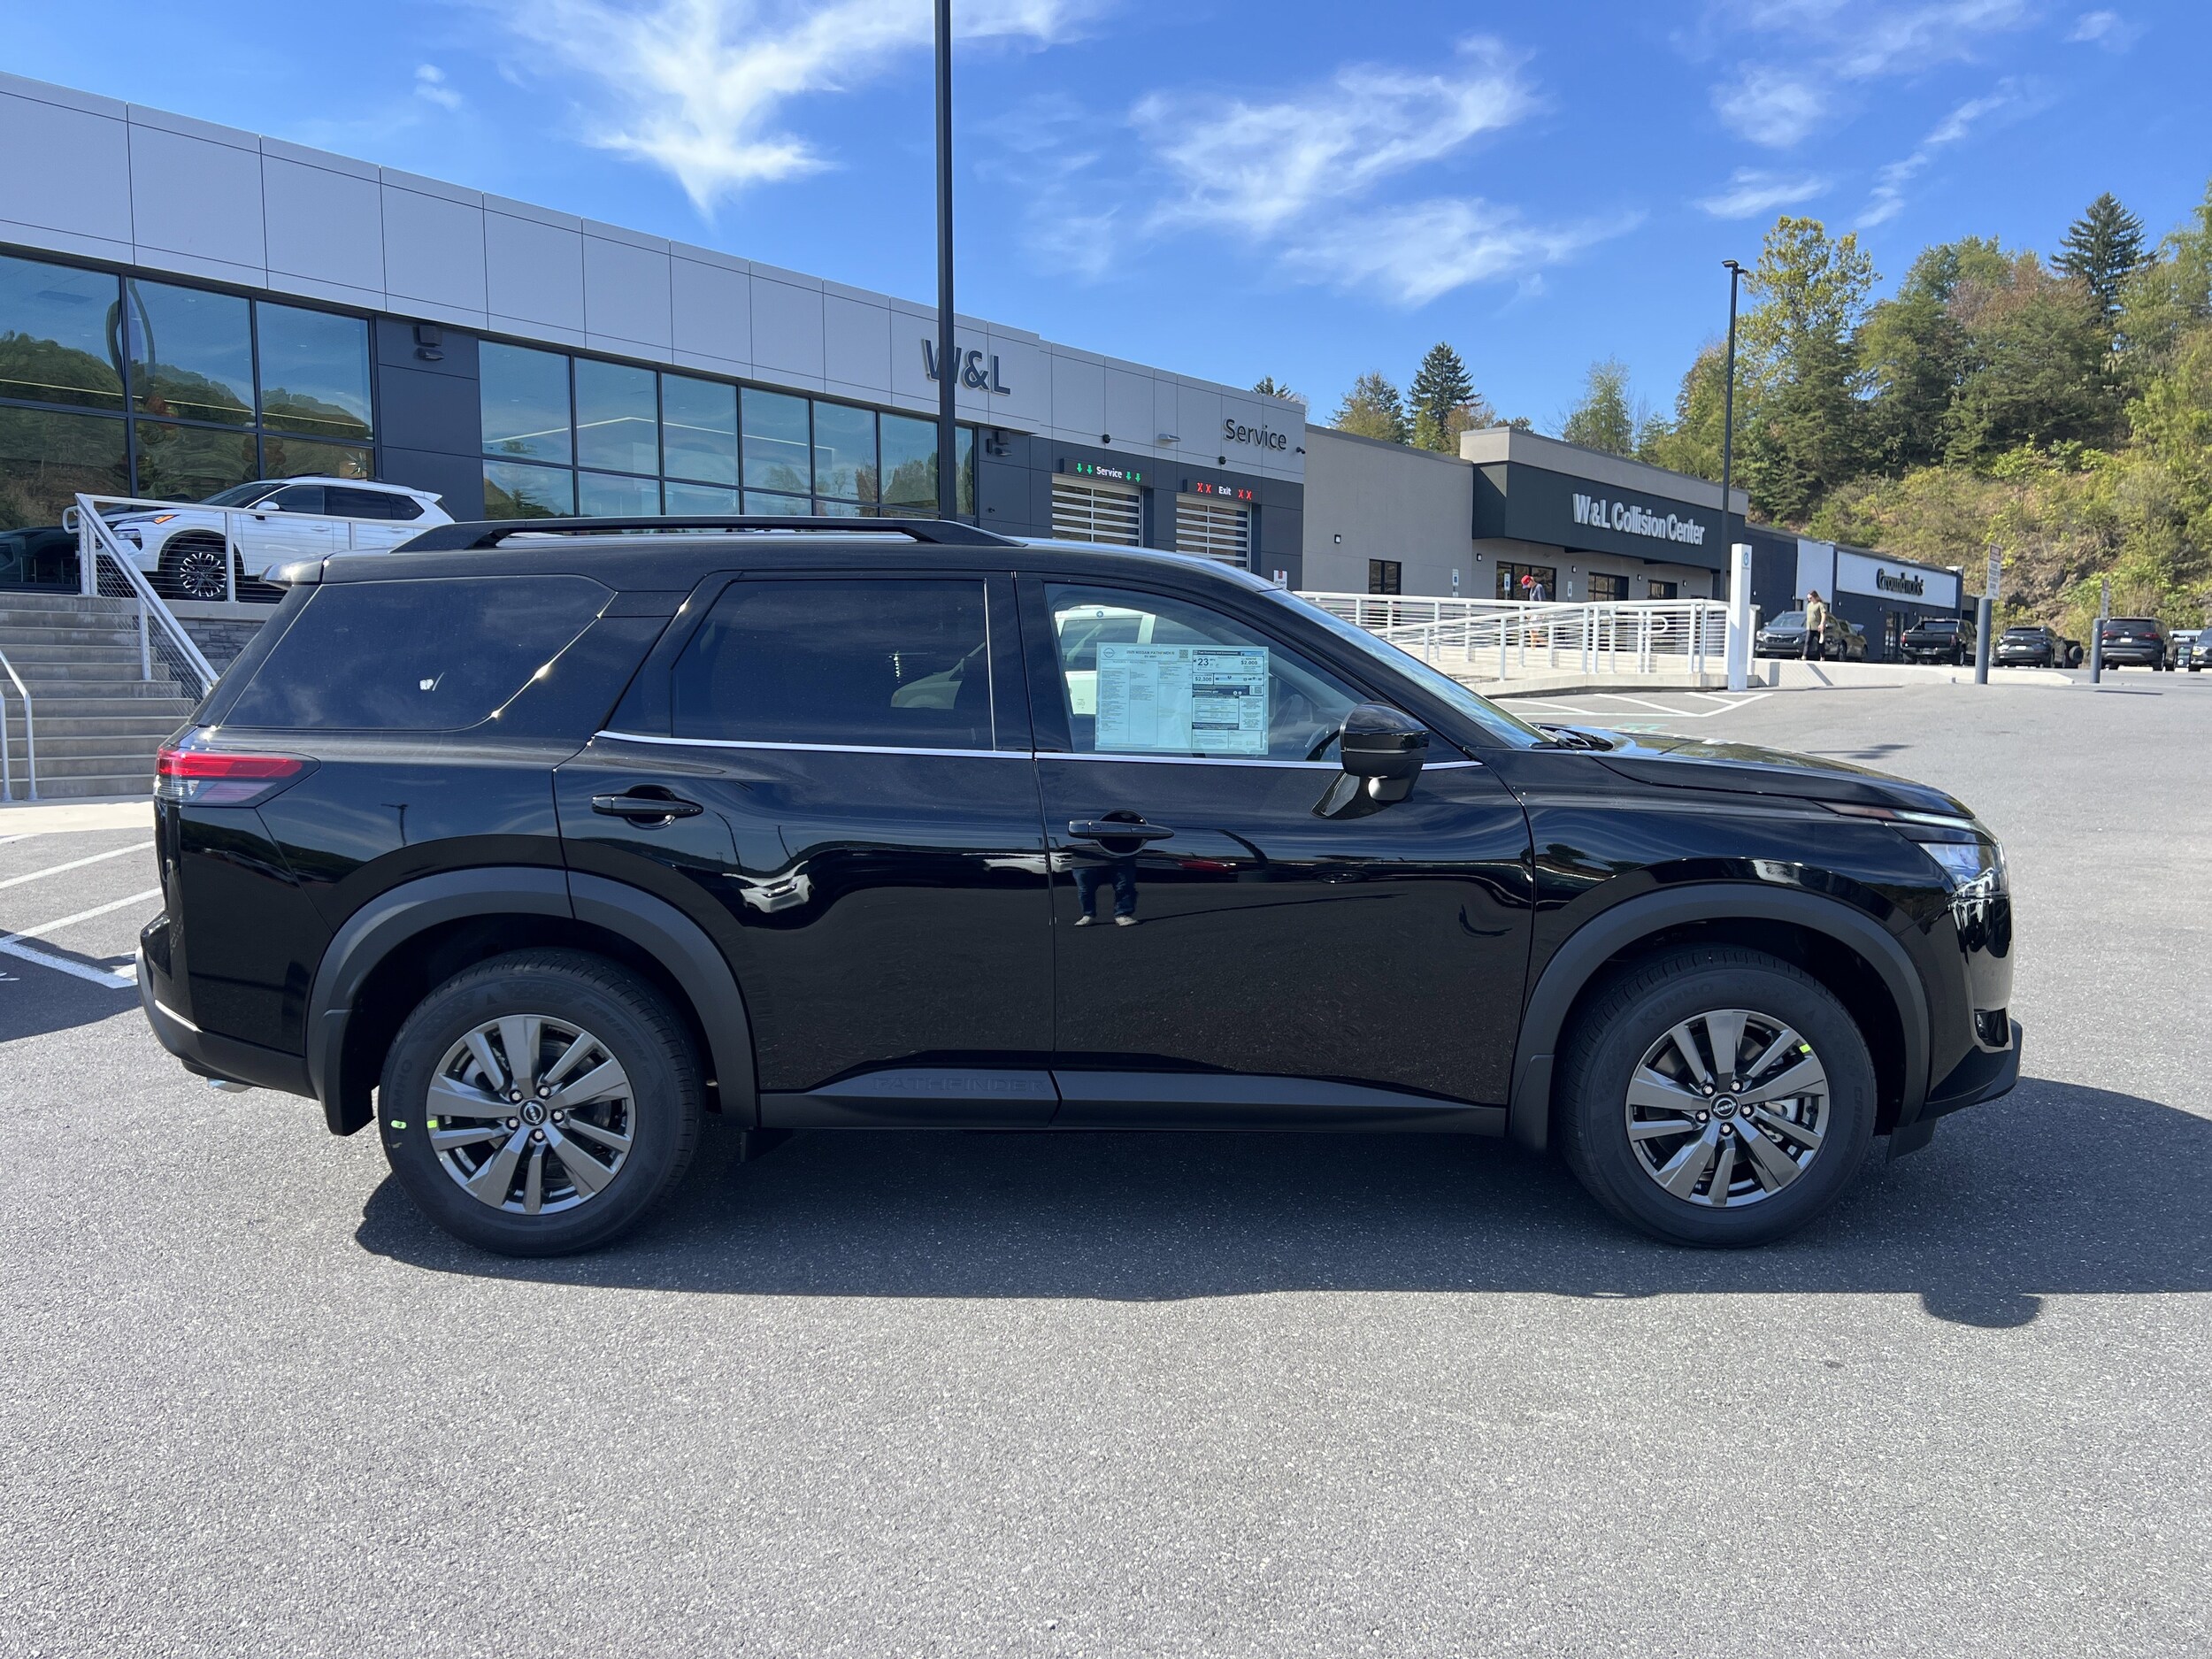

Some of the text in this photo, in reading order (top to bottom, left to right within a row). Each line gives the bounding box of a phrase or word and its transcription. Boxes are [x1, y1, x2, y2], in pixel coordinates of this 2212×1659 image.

[923, 339, 1011, 396] W&L
[1225, 419, 1287, 450] Service
[1095, 465, 1123, 479] Service
[1218, 486, 1232, 495] Exit
[1572, 493, 1705, 545] W&L Collision Center
[1197, 657, 1209, 666] 23
[870, 1076, 1048, 1094] PATHFINDER
